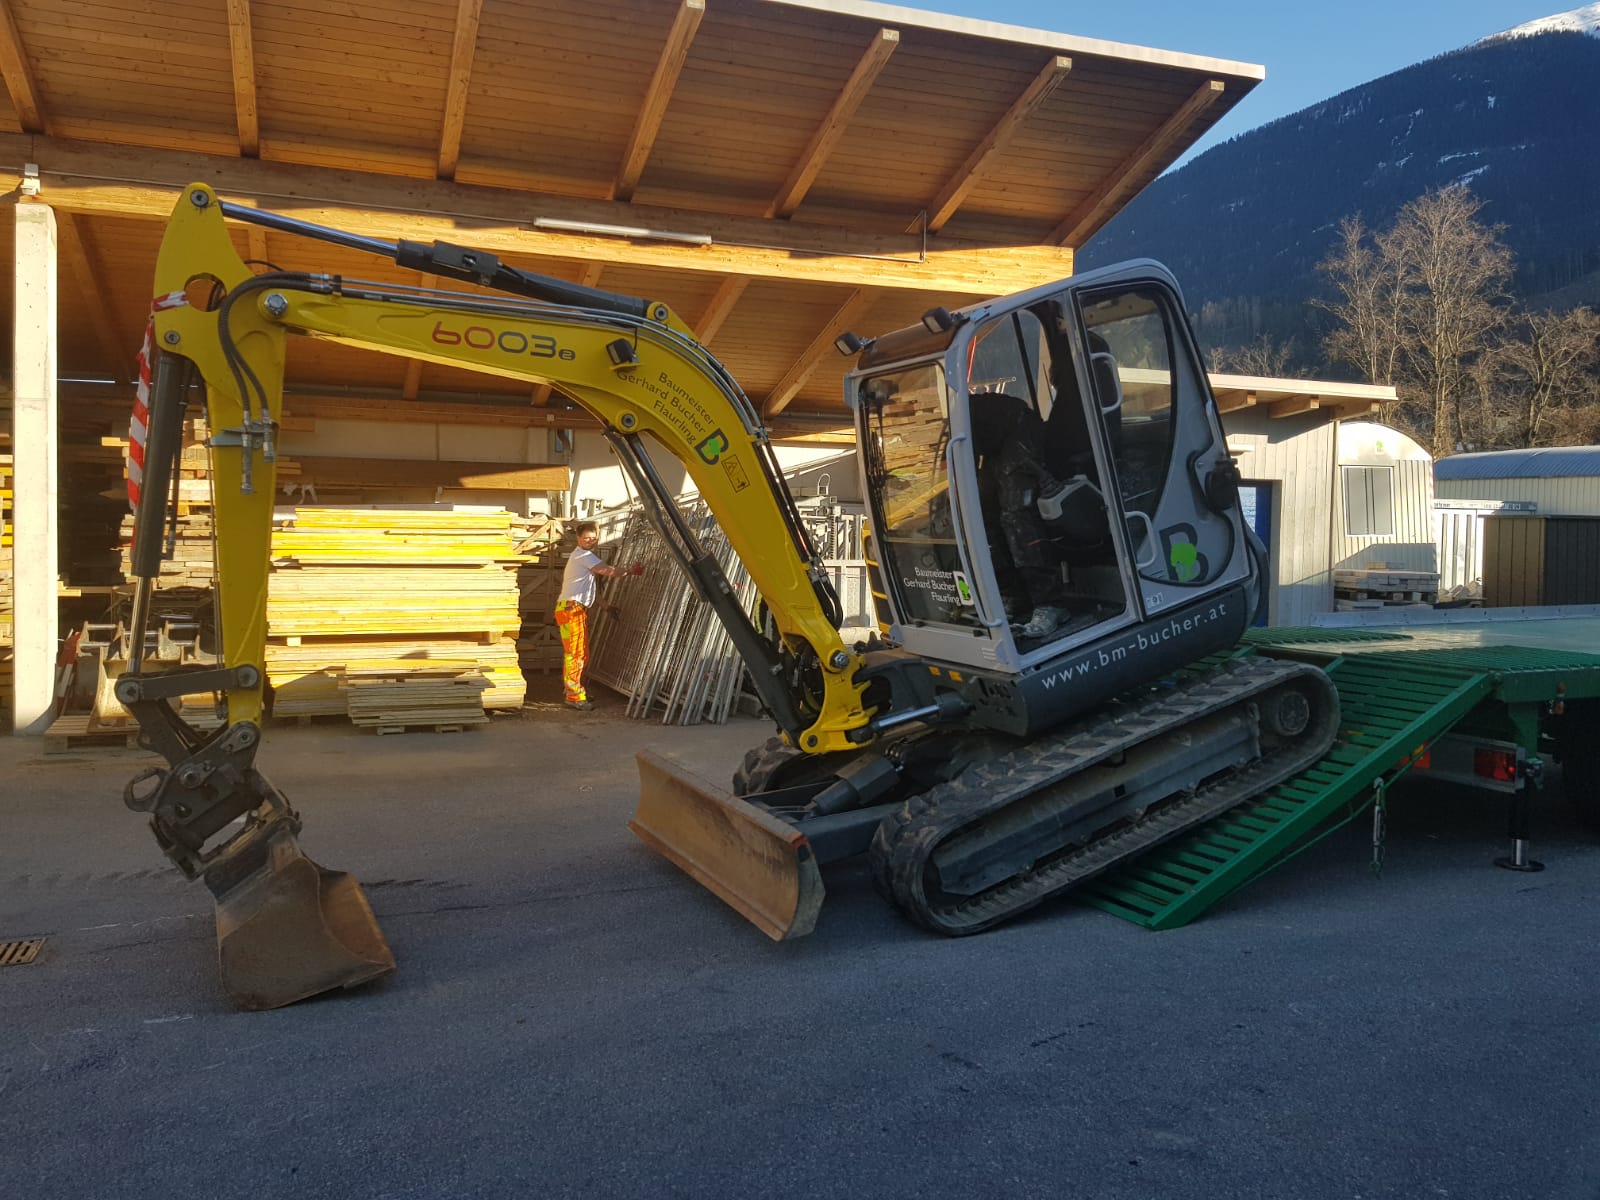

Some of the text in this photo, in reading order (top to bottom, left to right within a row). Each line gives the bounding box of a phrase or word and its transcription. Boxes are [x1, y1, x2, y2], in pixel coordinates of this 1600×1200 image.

[432, 321, 556, 358] 6003
[616, 370, 707, 433] Gerhard Bucher
[658, 371, 716, 426] Baumeister
[653, 399, 697, 445] Flaurling
[903, 577, 956, 592] Gerhard Bucher
[914, 566, 953, 579] Baumeister
[931, 591, 961, 606] Flaurling
[1041, 603, 1228, 690] www.bm-bucher.at
